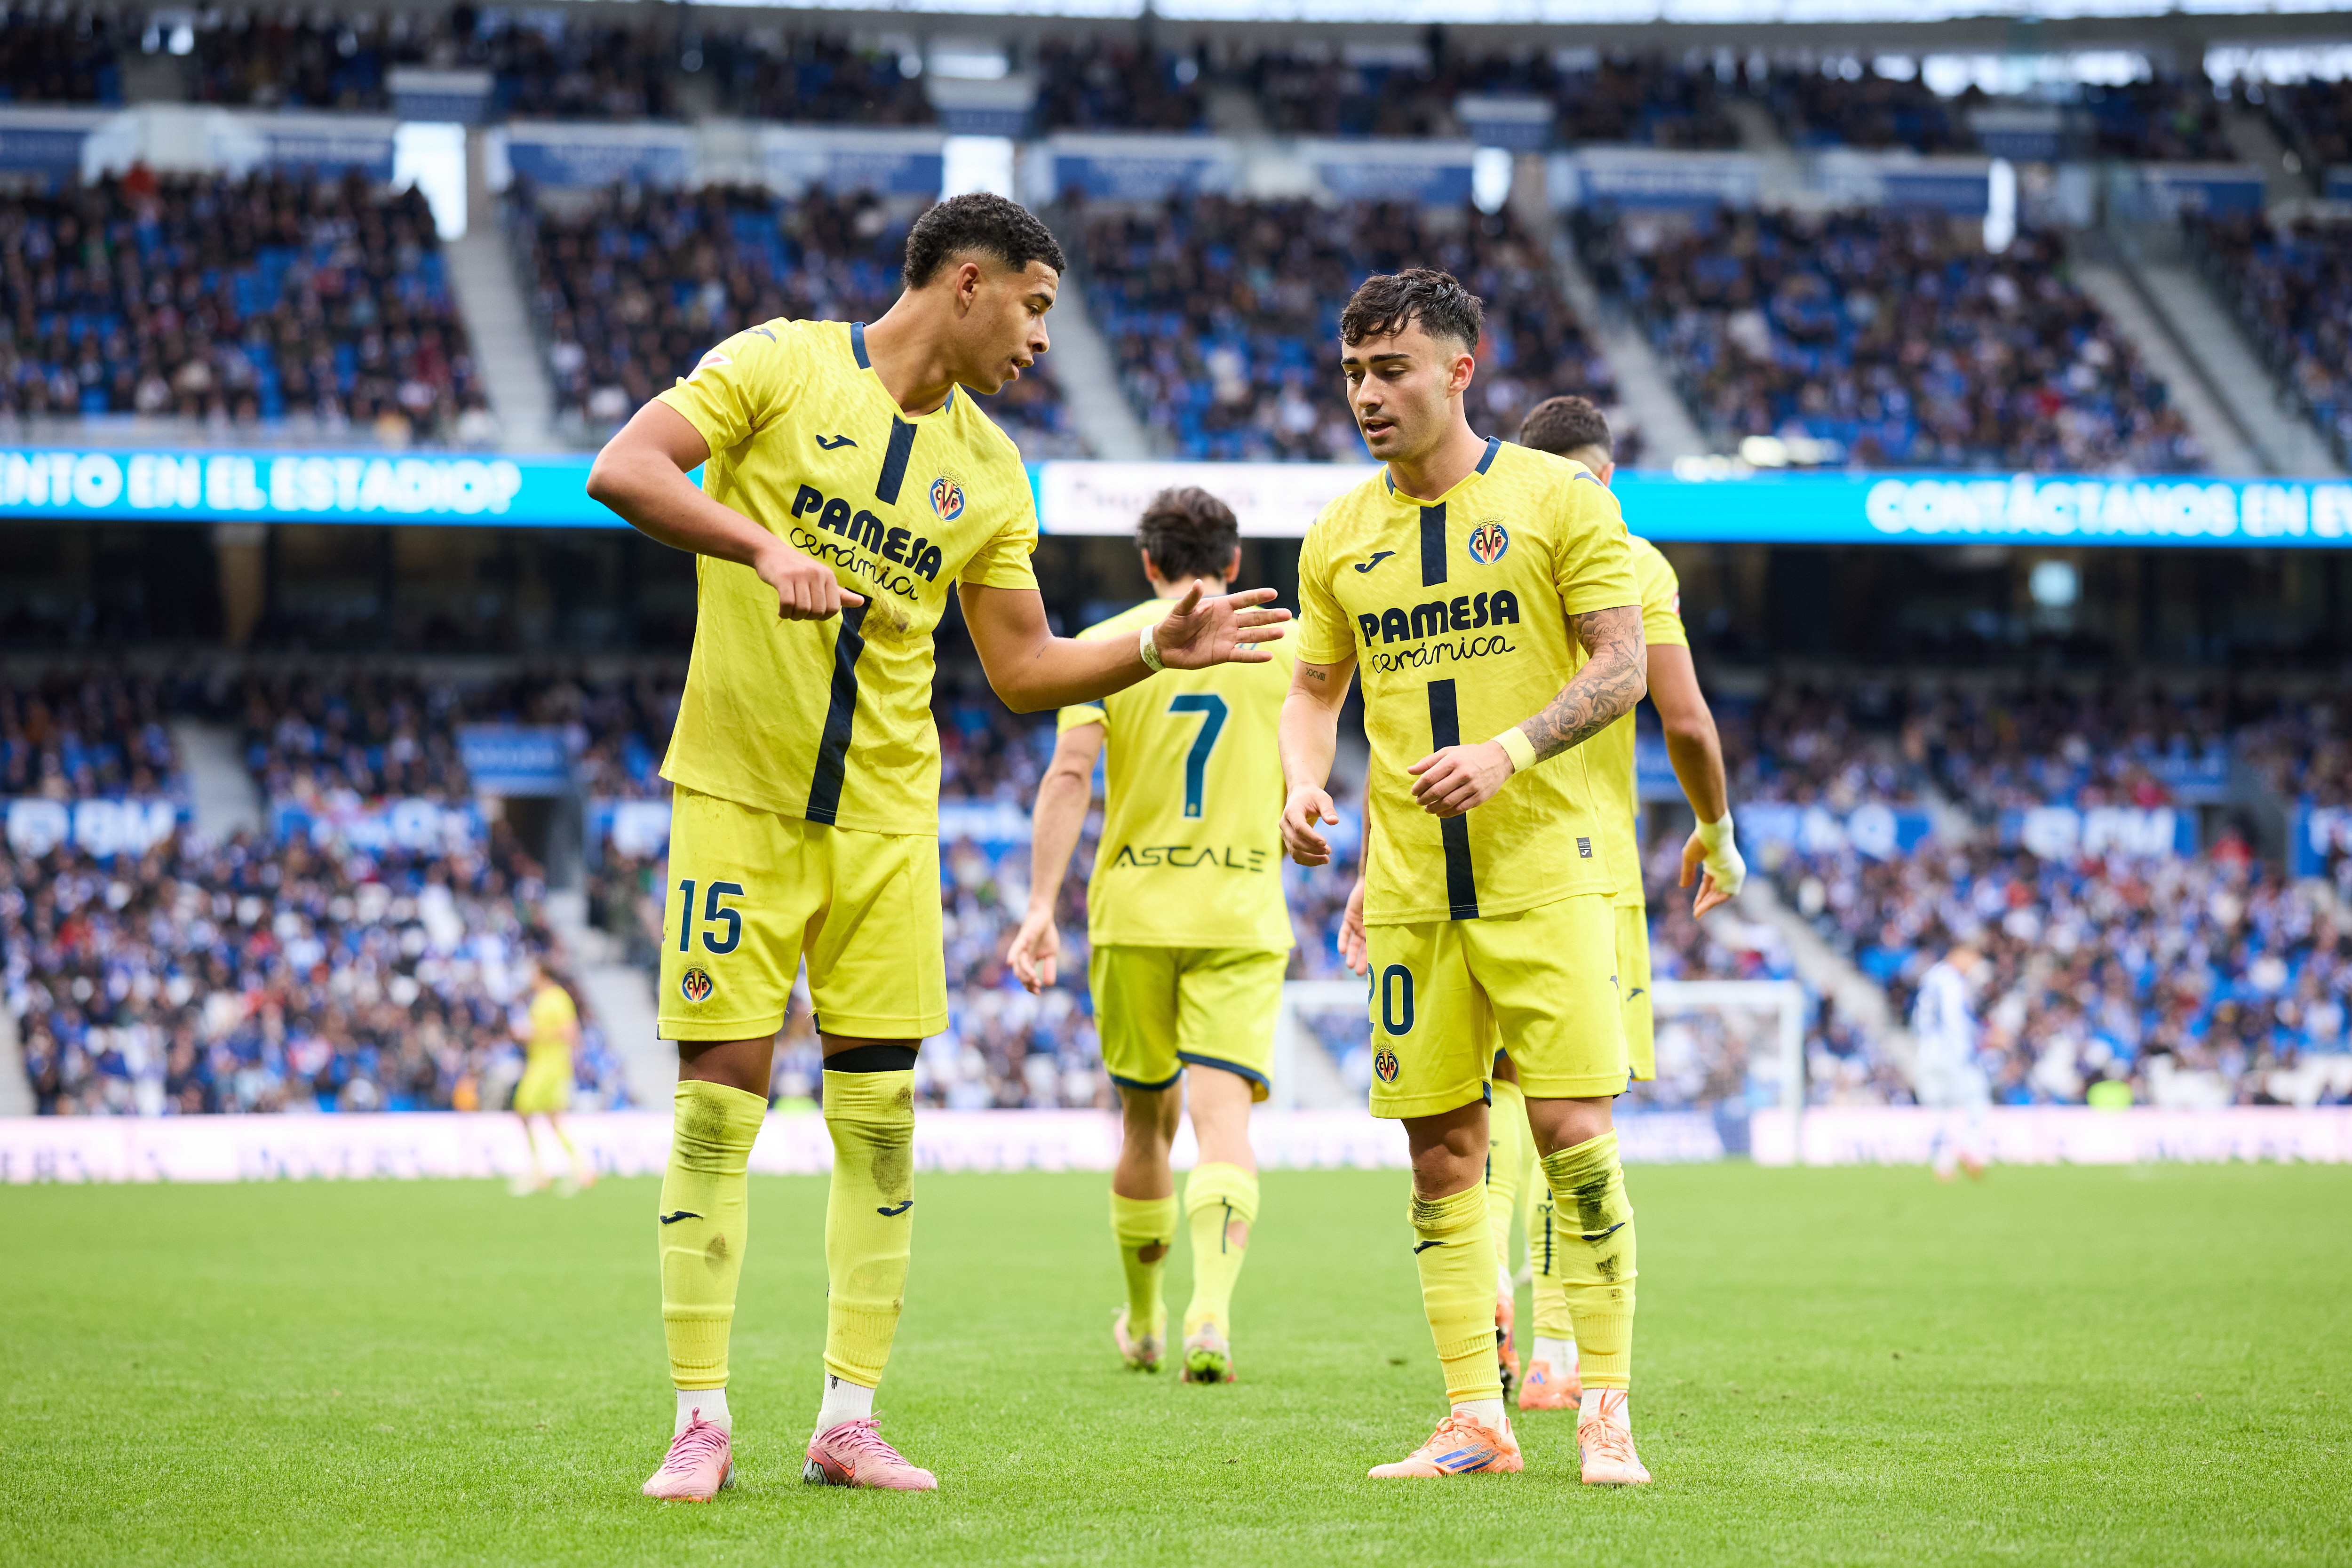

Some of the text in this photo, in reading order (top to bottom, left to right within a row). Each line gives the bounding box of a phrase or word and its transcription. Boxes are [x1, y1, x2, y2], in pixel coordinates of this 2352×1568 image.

[127, 453, 201, 509] EN
[206, 454, 267, 511] EL
[270, 456, 523, 515] ESTADIO?
[1866, 473, 2238, 536] CONTÁCTANOS
[2241, 484, 2308, 537] EN
[791, 484, 941, 582] PAMESA
[1358, 589, 1519, 647] PAMESA
[1372, 636, 1515, 674] cerámica
[1168, 693, 1229, 819] 7
[1111, 844, 1266, 873] ASCALE
[679, 879, 745, 954] 15
